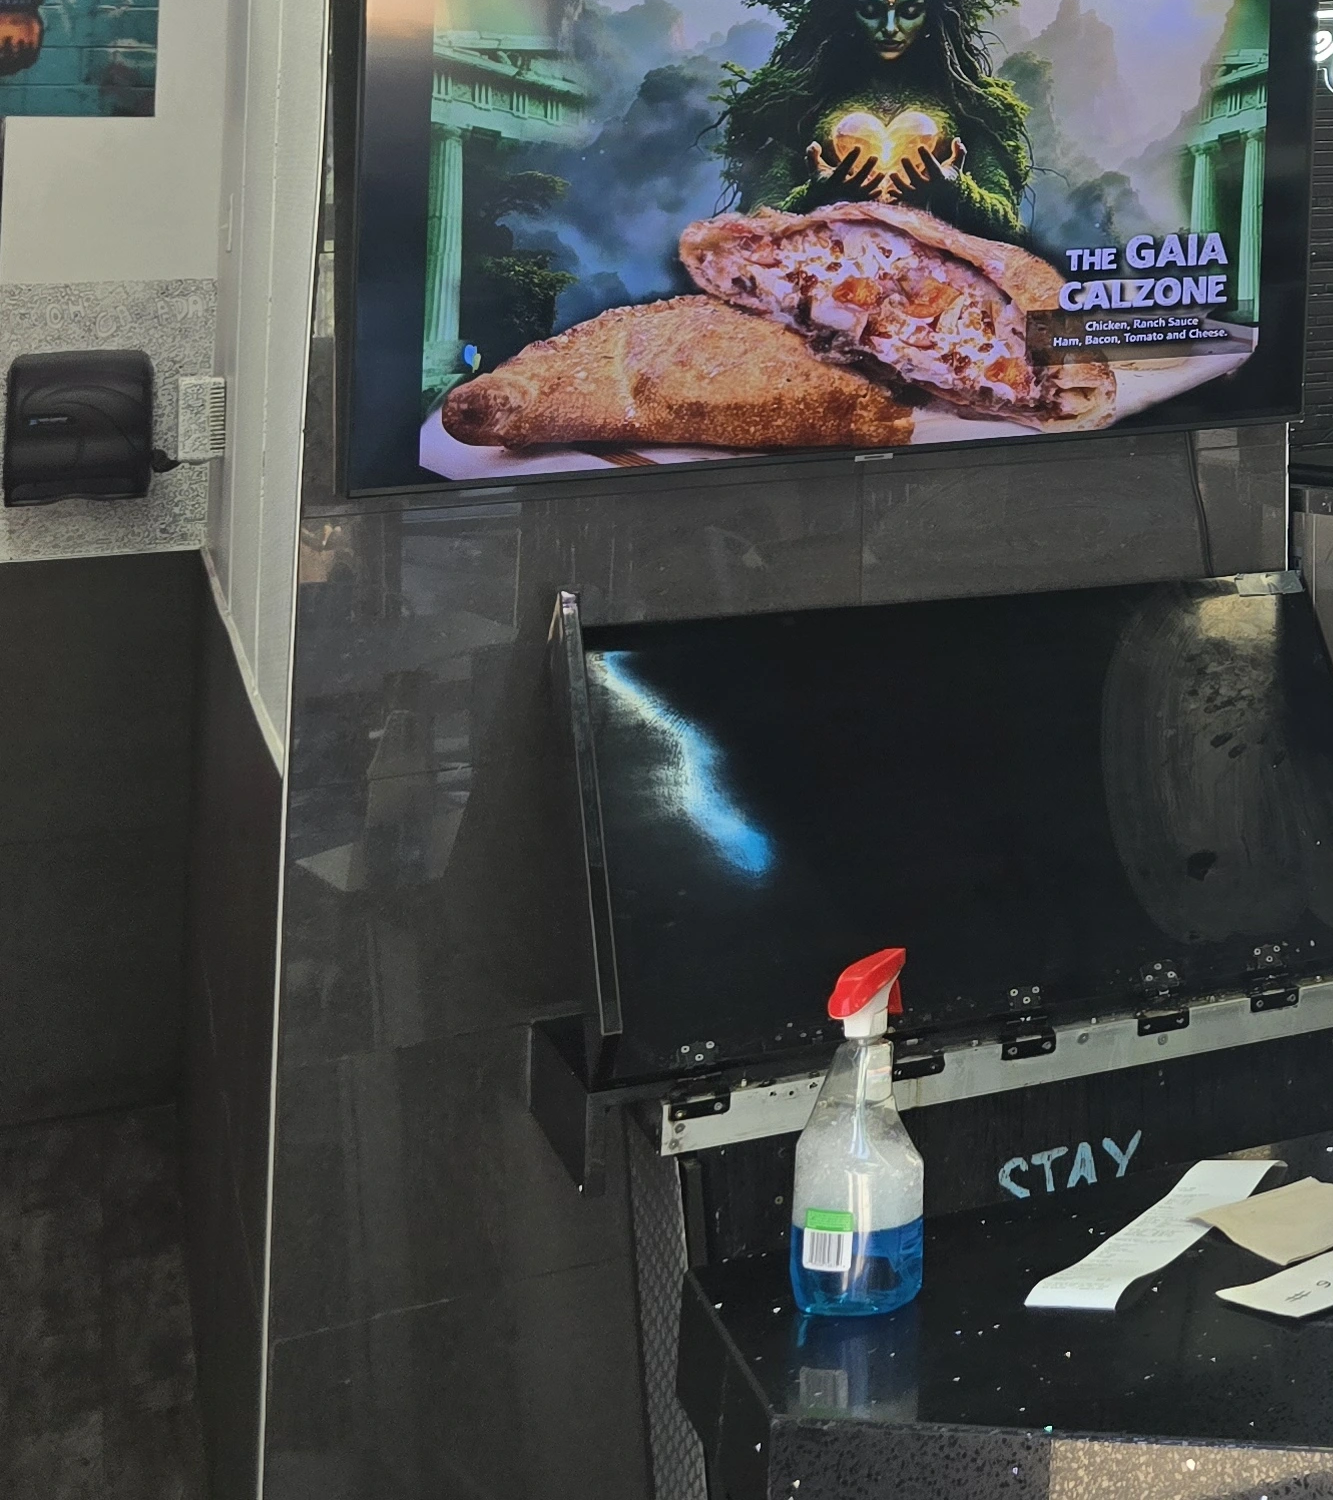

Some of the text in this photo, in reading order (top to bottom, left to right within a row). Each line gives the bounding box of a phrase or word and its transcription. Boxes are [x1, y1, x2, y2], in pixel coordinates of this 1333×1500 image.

[1066, 232, 1228, 271] THE GAIA
[1059, 275, 1227, 312] CALZONE
[1085, 317, 1199, 332] Chicken, Ranch Sauce
[1053, 337, 1082, 347] Ham,
[1085, 334, 1121, 345] Bacon,
[1124, 332, 1164, 343] Tomato
[1166, 330, 1186, 340] and
